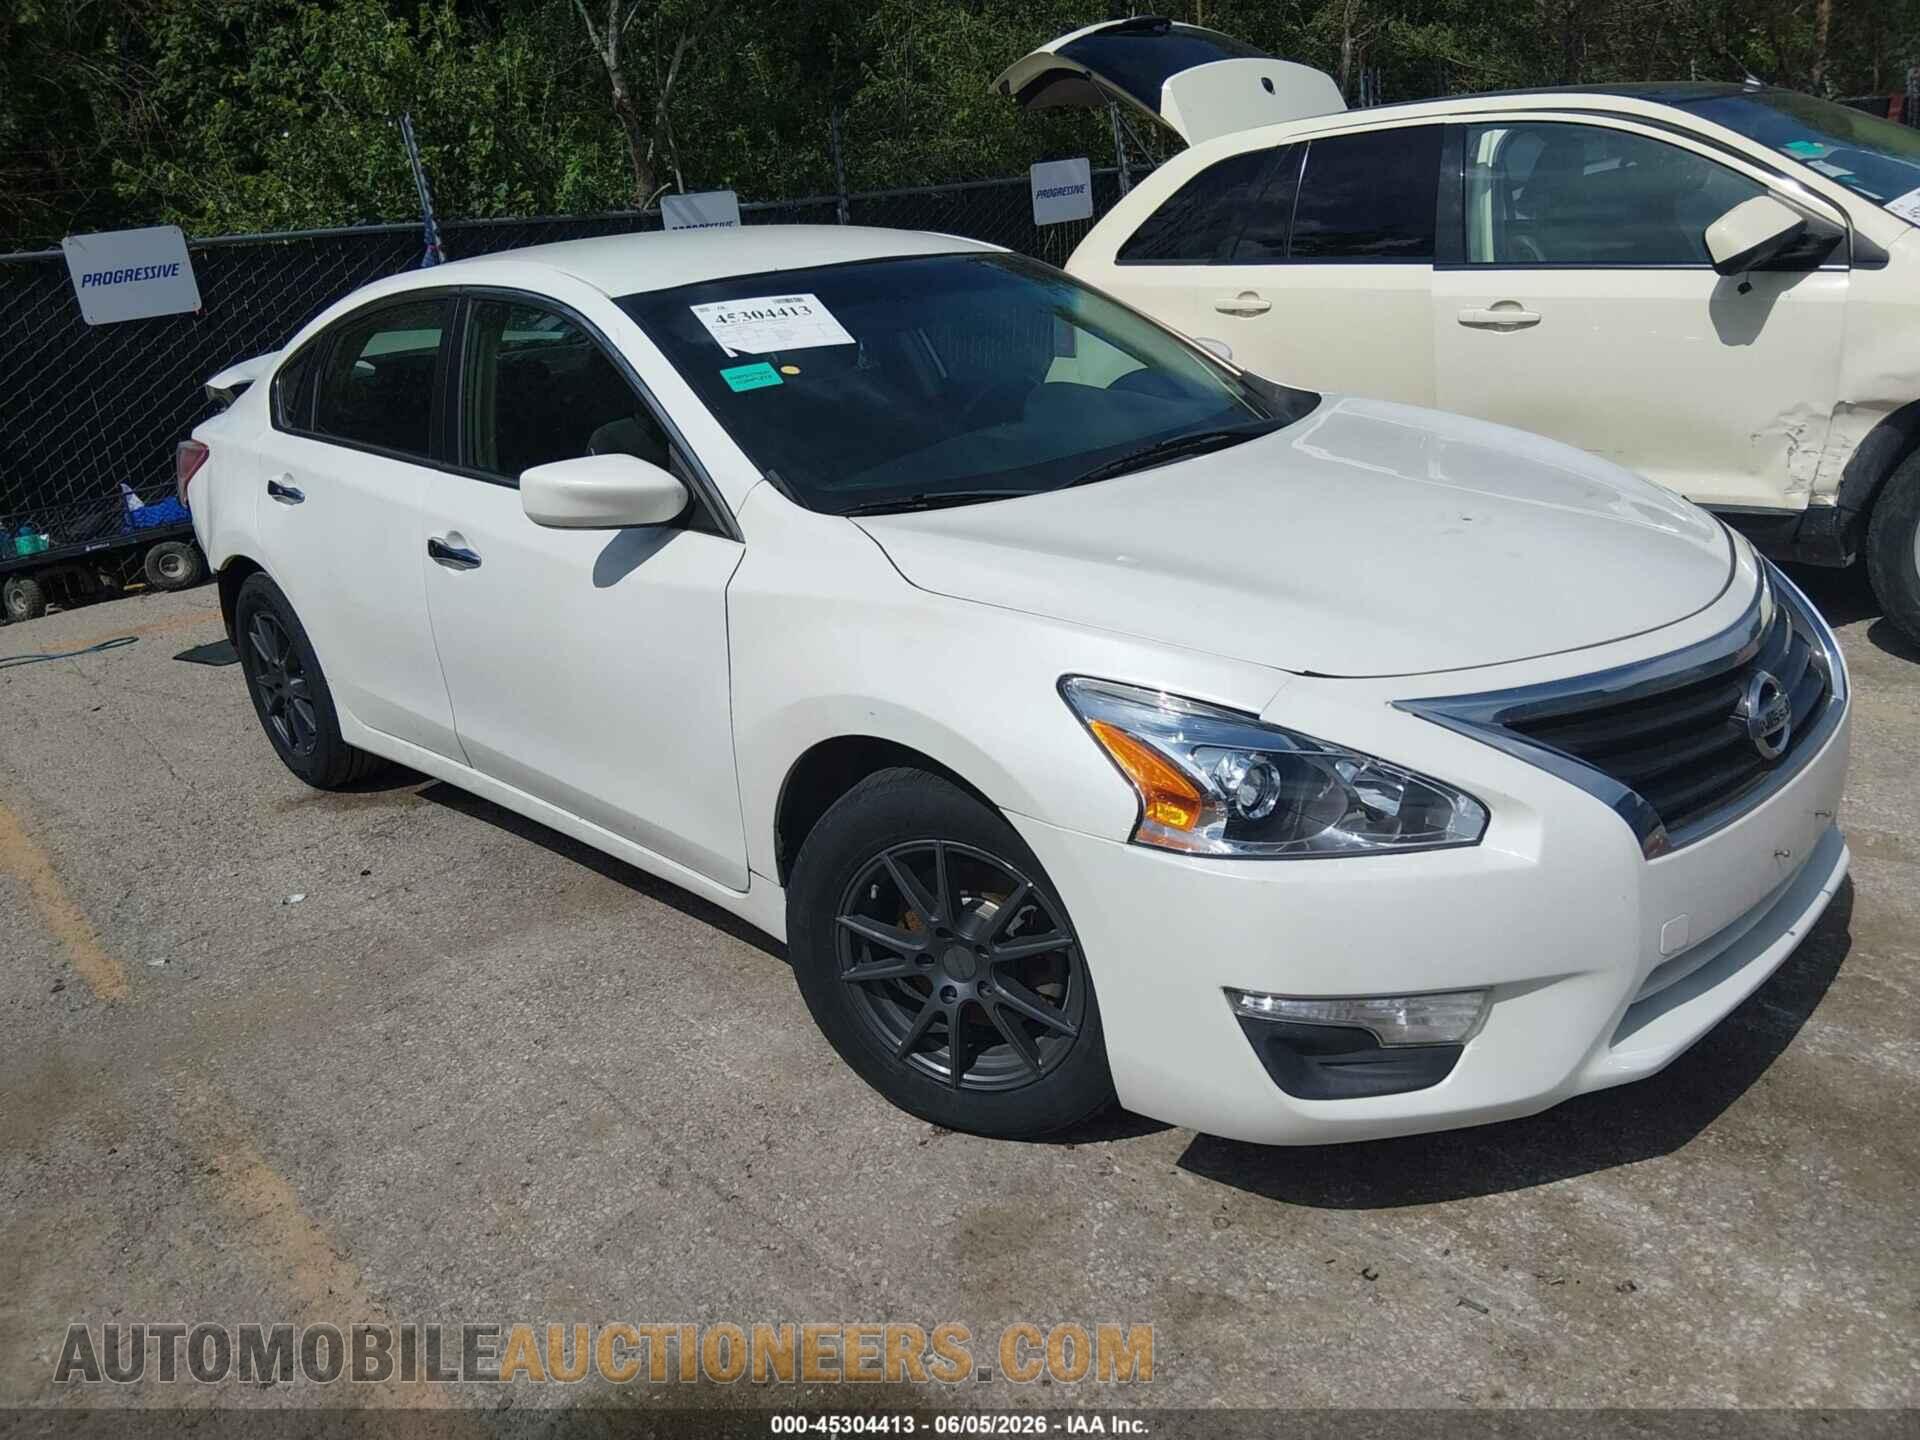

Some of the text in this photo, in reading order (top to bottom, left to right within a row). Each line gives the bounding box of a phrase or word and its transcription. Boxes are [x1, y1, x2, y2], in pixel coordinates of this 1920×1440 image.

[1035, 184, 1086, 200] PROGRESSIVE
[82, 263, 181, 288] PROGRESSIVE
[715, 305, 813, 324] 45304413
